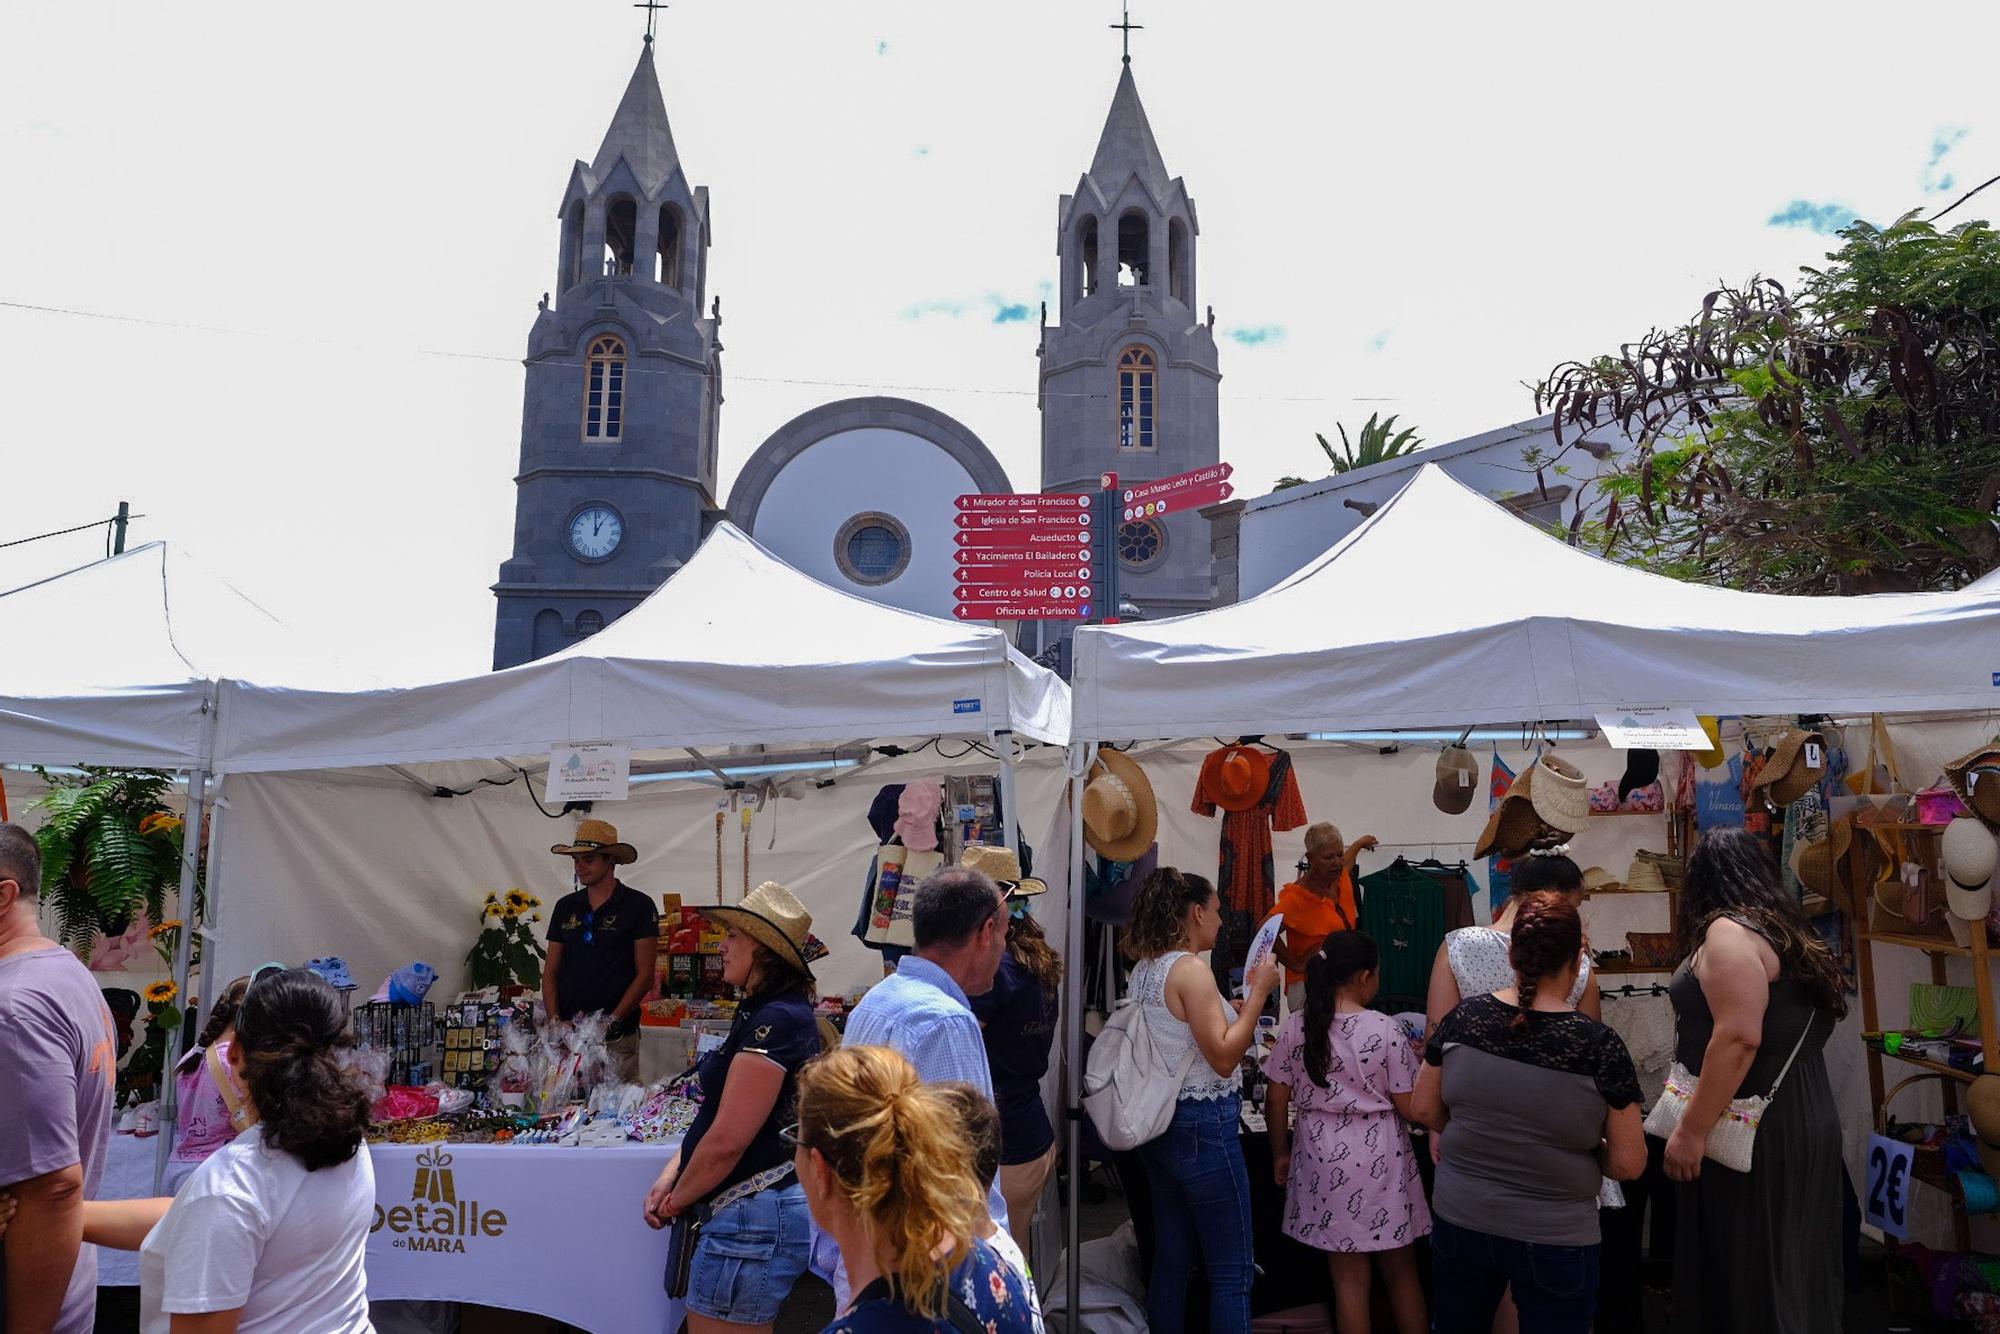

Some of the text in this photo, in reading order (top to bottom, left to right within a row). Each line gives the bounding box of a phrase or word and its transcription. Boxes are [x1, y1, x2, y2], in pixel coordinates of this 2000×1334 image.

[1134, 489, 1149, 498] Casa
[1150, 482, 1172, 495] Museo
[1172, 476, 1188, 489] León
[1194, 470, 1218, 482] Castillo
[973, 497, 1076, 506] Mirador de San Francisco
[981, 515, 1076, 526] Iglesia de San Francisco
[1029, 533, 1076, 542] Acueducto
[975, 551, 1076, 561] Yacimiento El Bailadero
[1054, 569, 1076, 578] Local
[979, 587, 1047, 597] Centro de Salud
[995, 606, 1077, 615] Oficina de Turismo
[1868, 1145, 1908, 1225] 2€
[392, 1237, 466, 1253] de MARA
